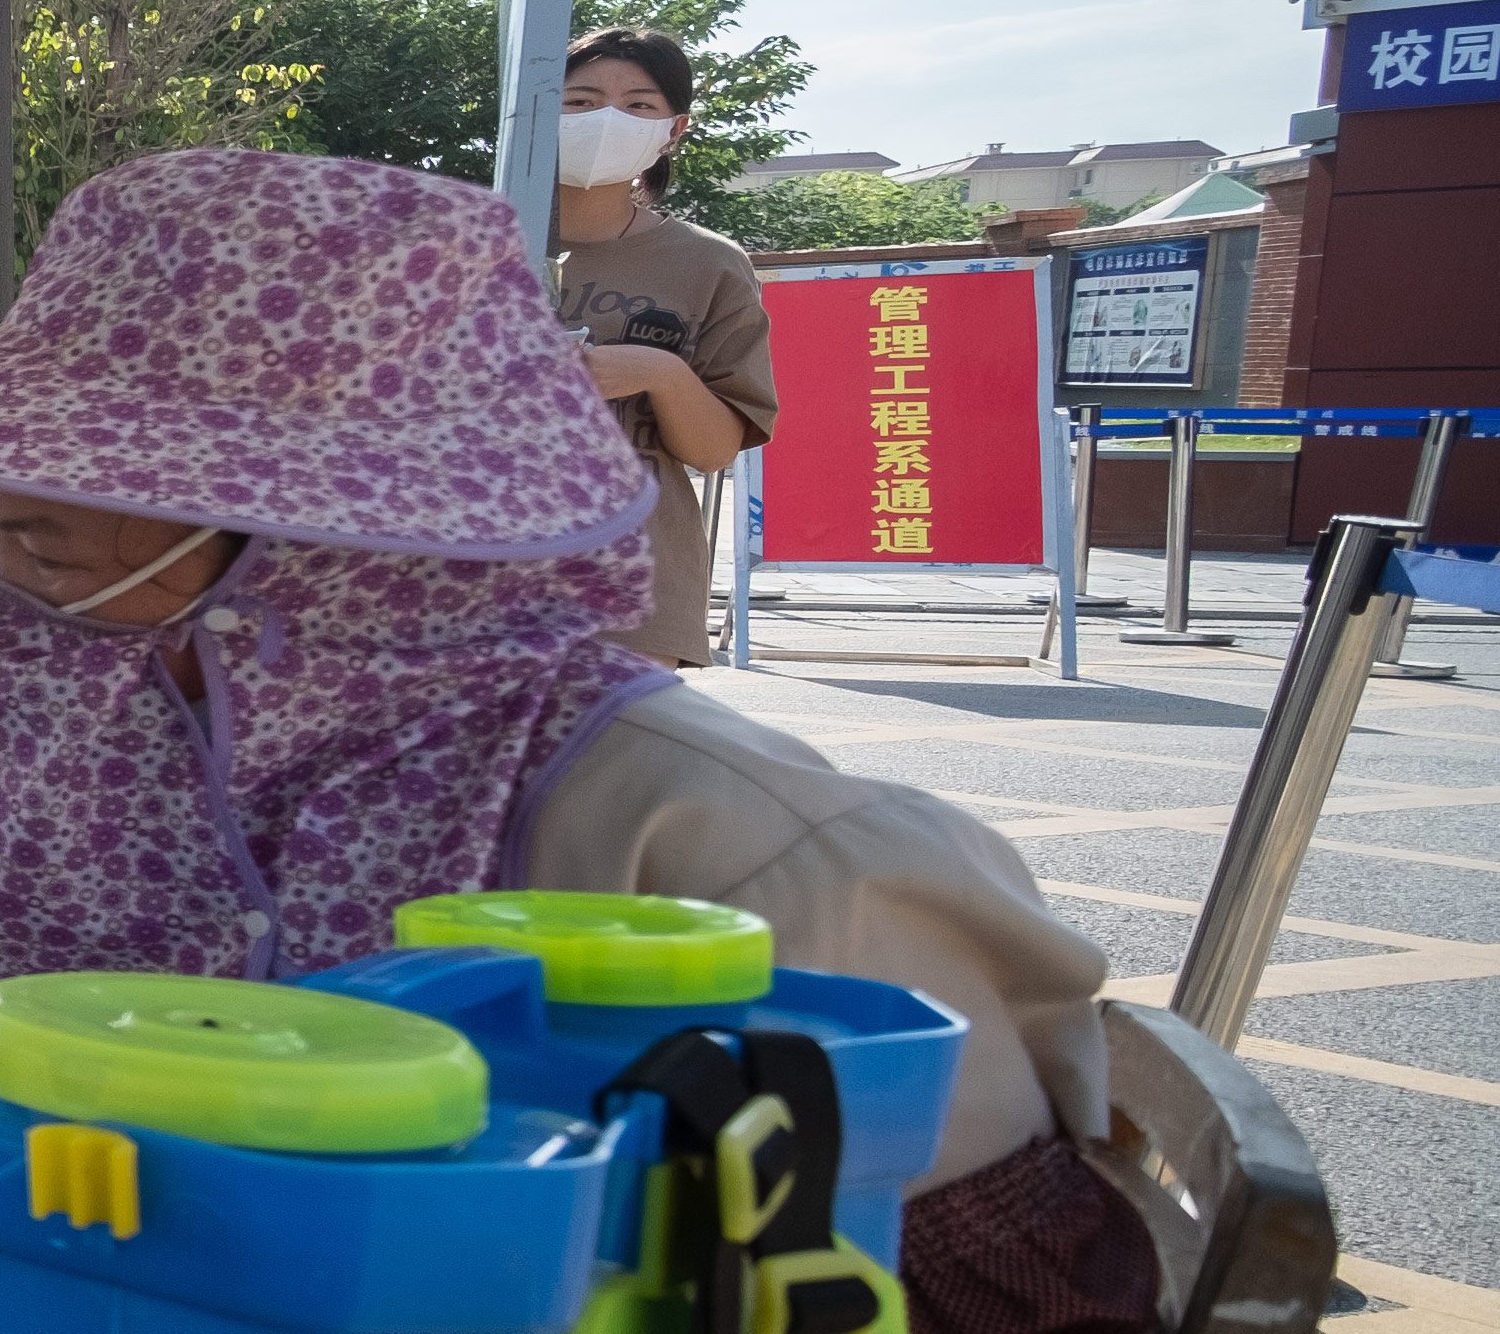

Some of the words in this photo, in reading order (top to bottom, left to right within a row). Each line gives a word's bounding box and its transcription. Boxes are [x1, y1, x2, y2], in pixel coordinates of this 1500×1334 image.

[1367, 23, 1500, 90] 校园
[869, 285, 935, 557] 管理工程系通道
[1314, 424, 1379, 437] 警戒线
